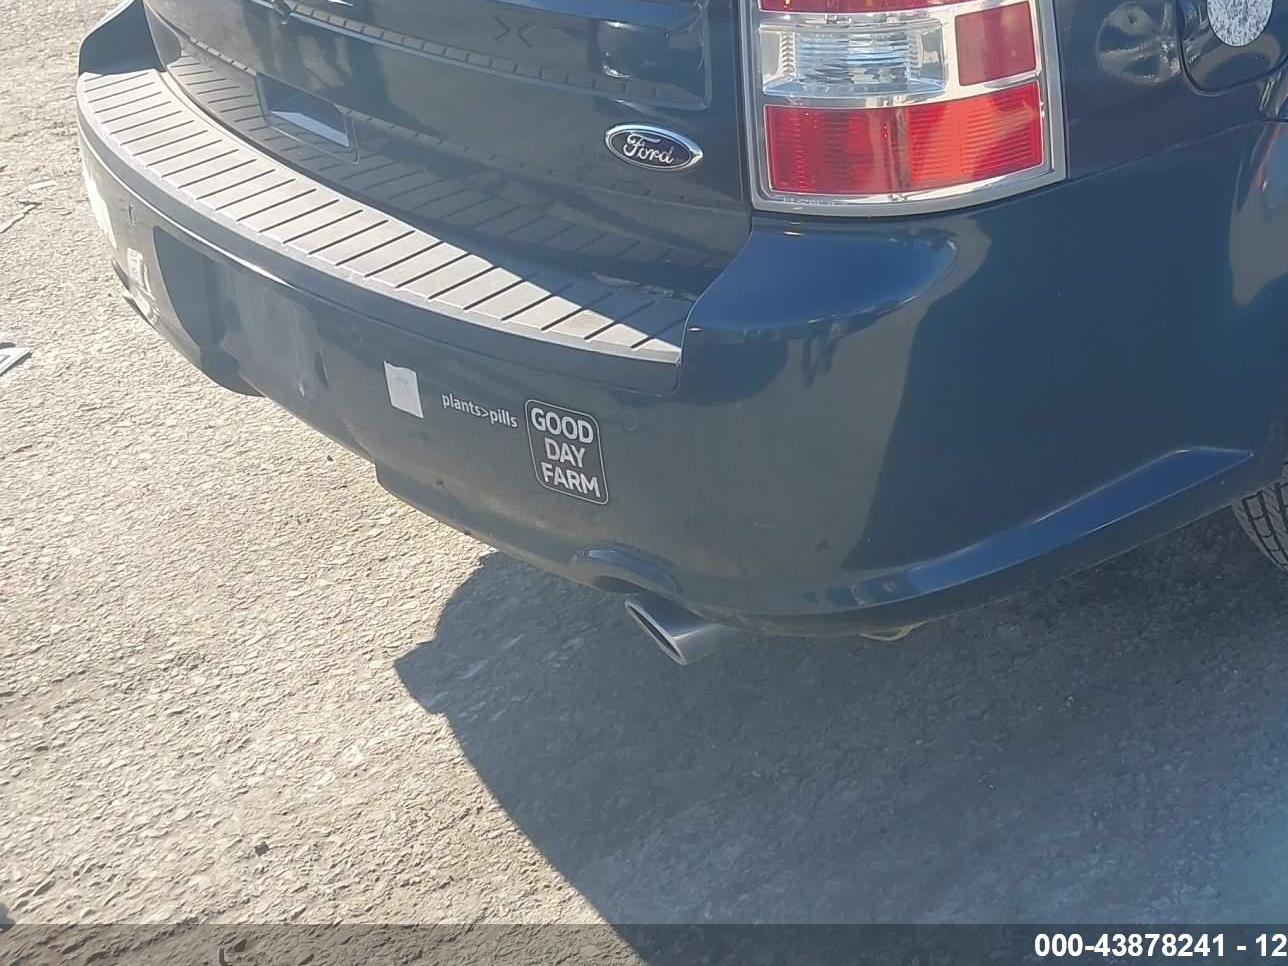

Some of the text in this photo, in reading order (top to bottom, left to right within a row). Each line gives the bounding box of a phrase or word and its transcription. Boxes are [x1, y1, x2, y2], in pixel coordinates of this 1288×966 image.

[622, 132, 675, 164] Ford
[441, 392, 518, 428] plants>pills
[531, 407, 593, 444] GOOD
[543, 436, 586, 469] DAY
[540, 461, 601, 499] FARM
